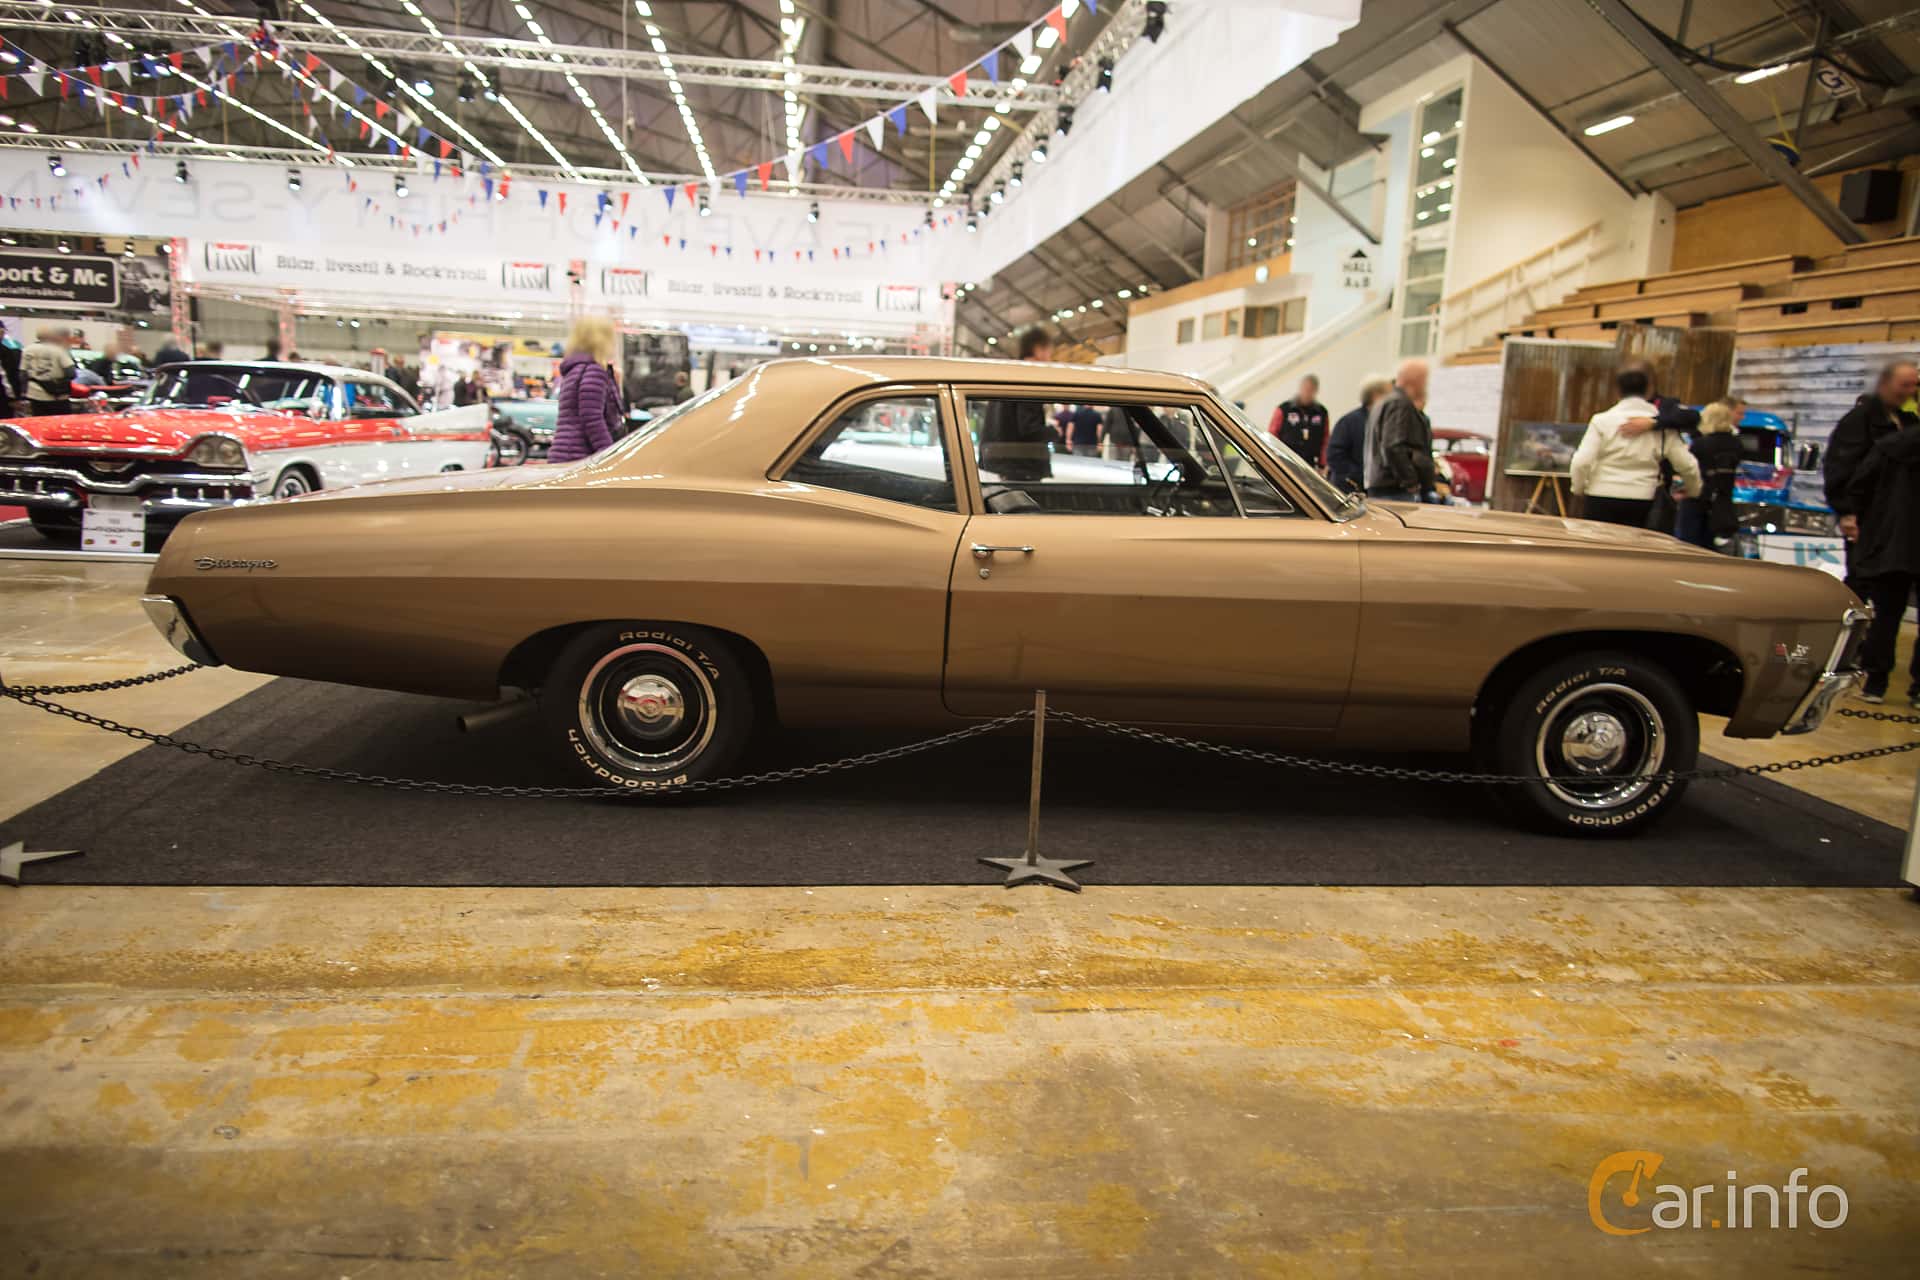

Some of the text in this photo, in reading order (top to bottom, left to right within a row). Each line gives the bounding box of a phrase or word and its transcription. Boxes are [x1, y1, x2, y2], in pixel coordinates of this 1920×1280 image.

[48, 266, 69, 284] &
[73, 267, 108, 287] Mc
[385, 262, 396, 276] &
[1342, 262, 1372, 273] HALL
[619, 630, 721, 681] Radial T/A
[1535, 666, 1628, 716] Radial T/A
[567, 728, 688, 791] BFGoodrich
